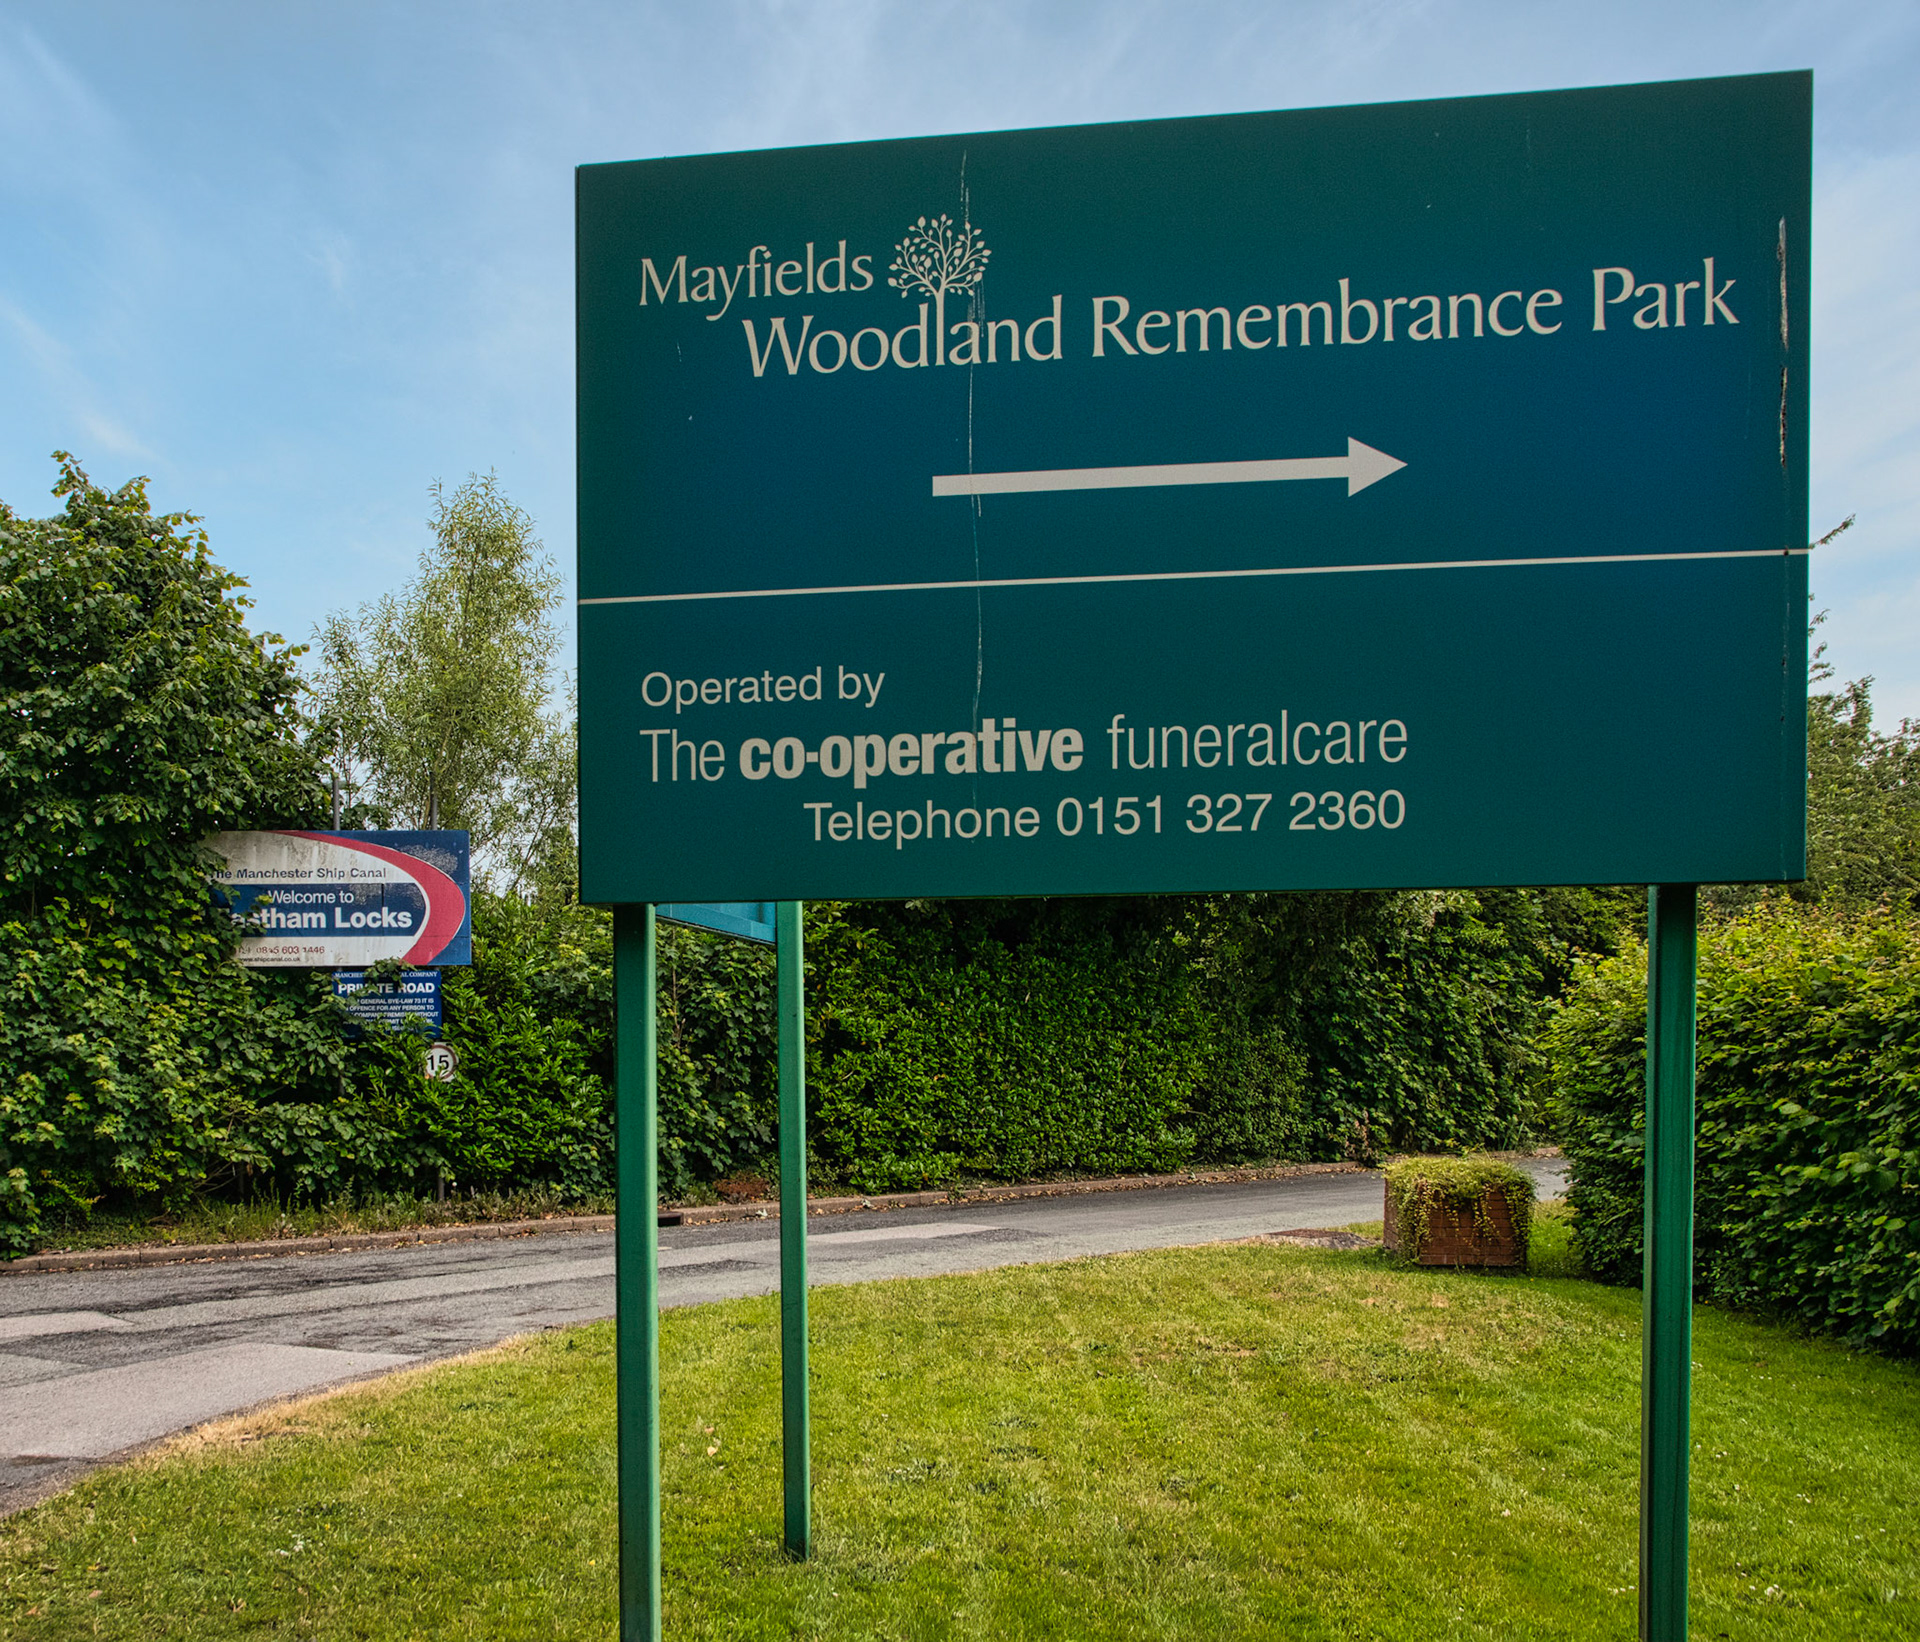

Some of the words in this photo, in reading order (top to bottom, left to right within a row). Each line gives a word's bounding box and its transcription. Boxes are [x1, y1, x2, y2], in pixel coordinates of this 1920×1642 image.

[639, 240, 874, 321] Mayfields
[741, 294, 1063, 377] Woodland
[1092, 277, 1563, 357] Remembrance
[1592, 257, 1740, 331] Park
[640, 666, 822, 714] Operated
[838, 666, 885, 708] by
[640, 728, 725, 782] The
[739, 717, 1084, 789] co-operative
[1106, 709, 1408, 770] funeralcare
[803, 801, 1040, 850] Telephone
[1056, 795, 1161, 836] 0151
[1186, 793, 1273, 833] 327
[1289, 789, 1406, 830] 2360
[236, 868, 314, 879] Manchester
[316, 867, 346, 880] Ship
[350, 867, 387, 878] Canal
[267, 889, 336, 904] Welcome
[339, 890, 355, 904] to
[334, 906, 413, 929] Locks
[281, 946, 300, 955] 603
[398, 982, 436, 994] ROAD
[427, 1054, 449, 1070] 15
